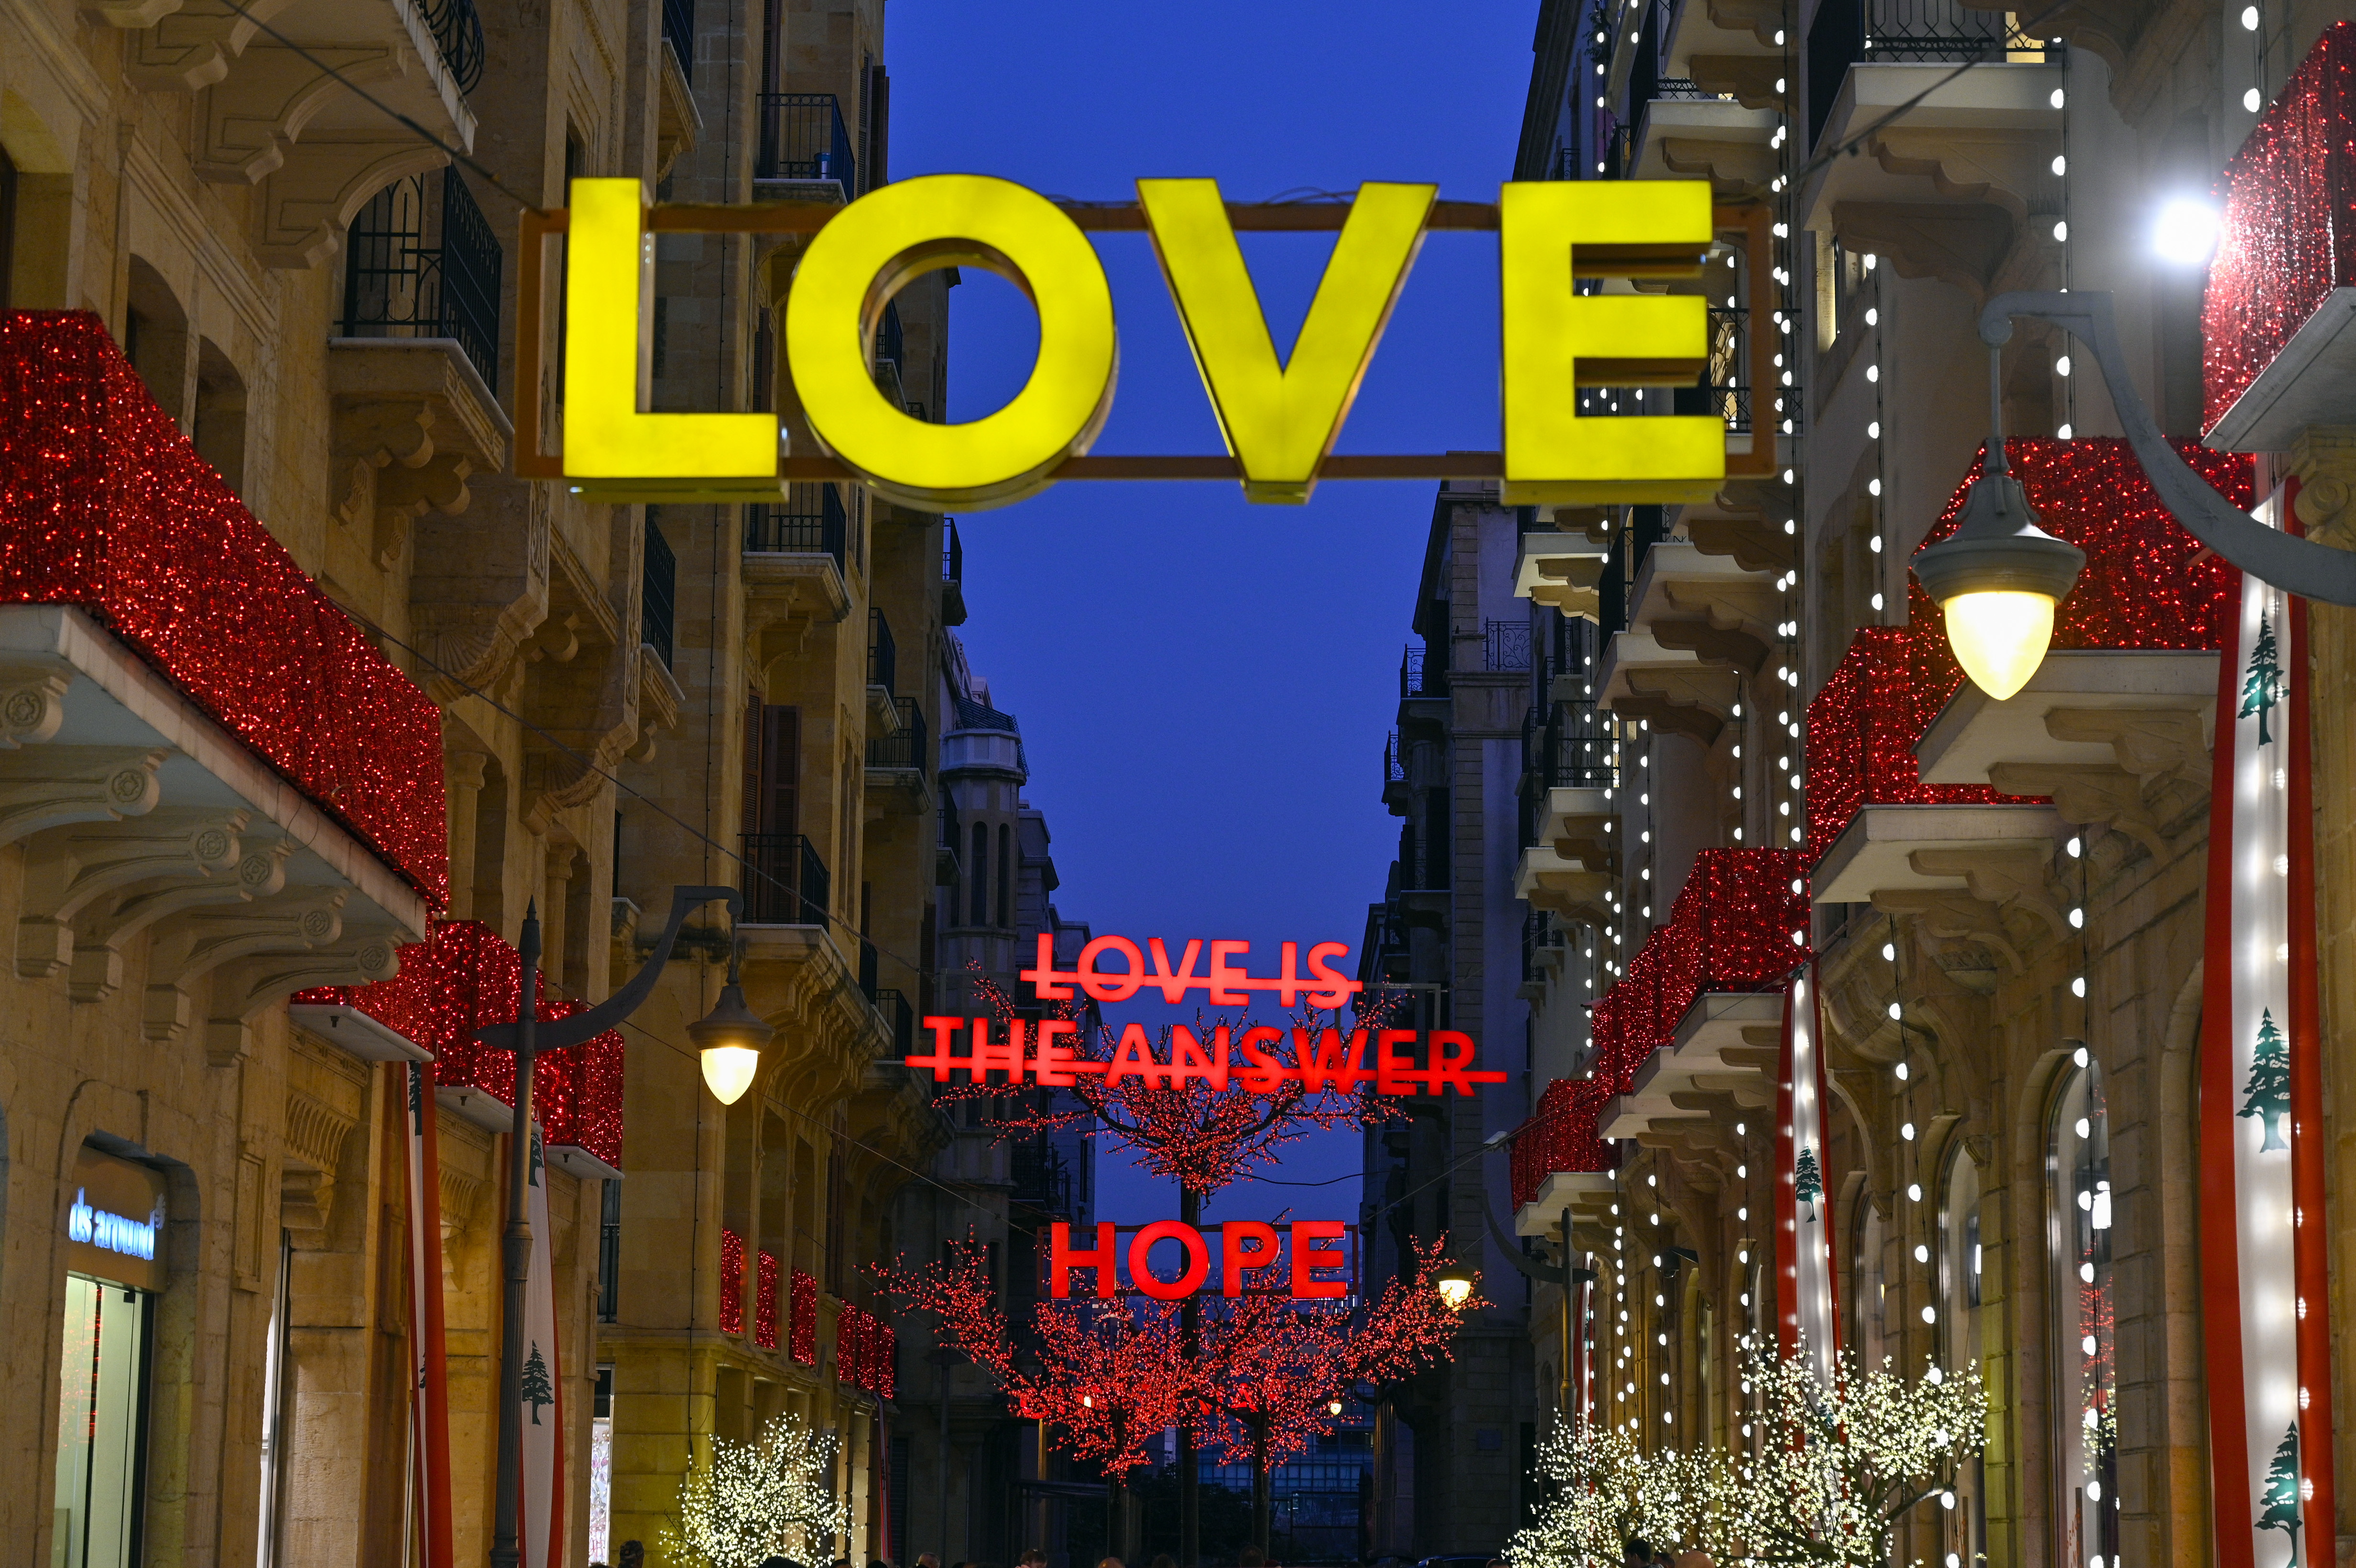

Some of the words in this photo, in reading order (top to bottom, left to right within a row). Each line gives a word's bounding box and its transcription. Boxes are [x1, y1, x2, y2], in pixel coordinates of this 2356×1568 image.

[563, 173, 1727, 503] LOVE
[1036, 933, 1249, 1006] LOVE
[1281, 941, 1350, 1010] IS
[923, 1016, 1078, 1087] THE
[1103, 1023, 1476, 1097] ANSWER
[95, 1209, 155, 1261] around
[1050, 1219, 1348, 1300] HOPE
